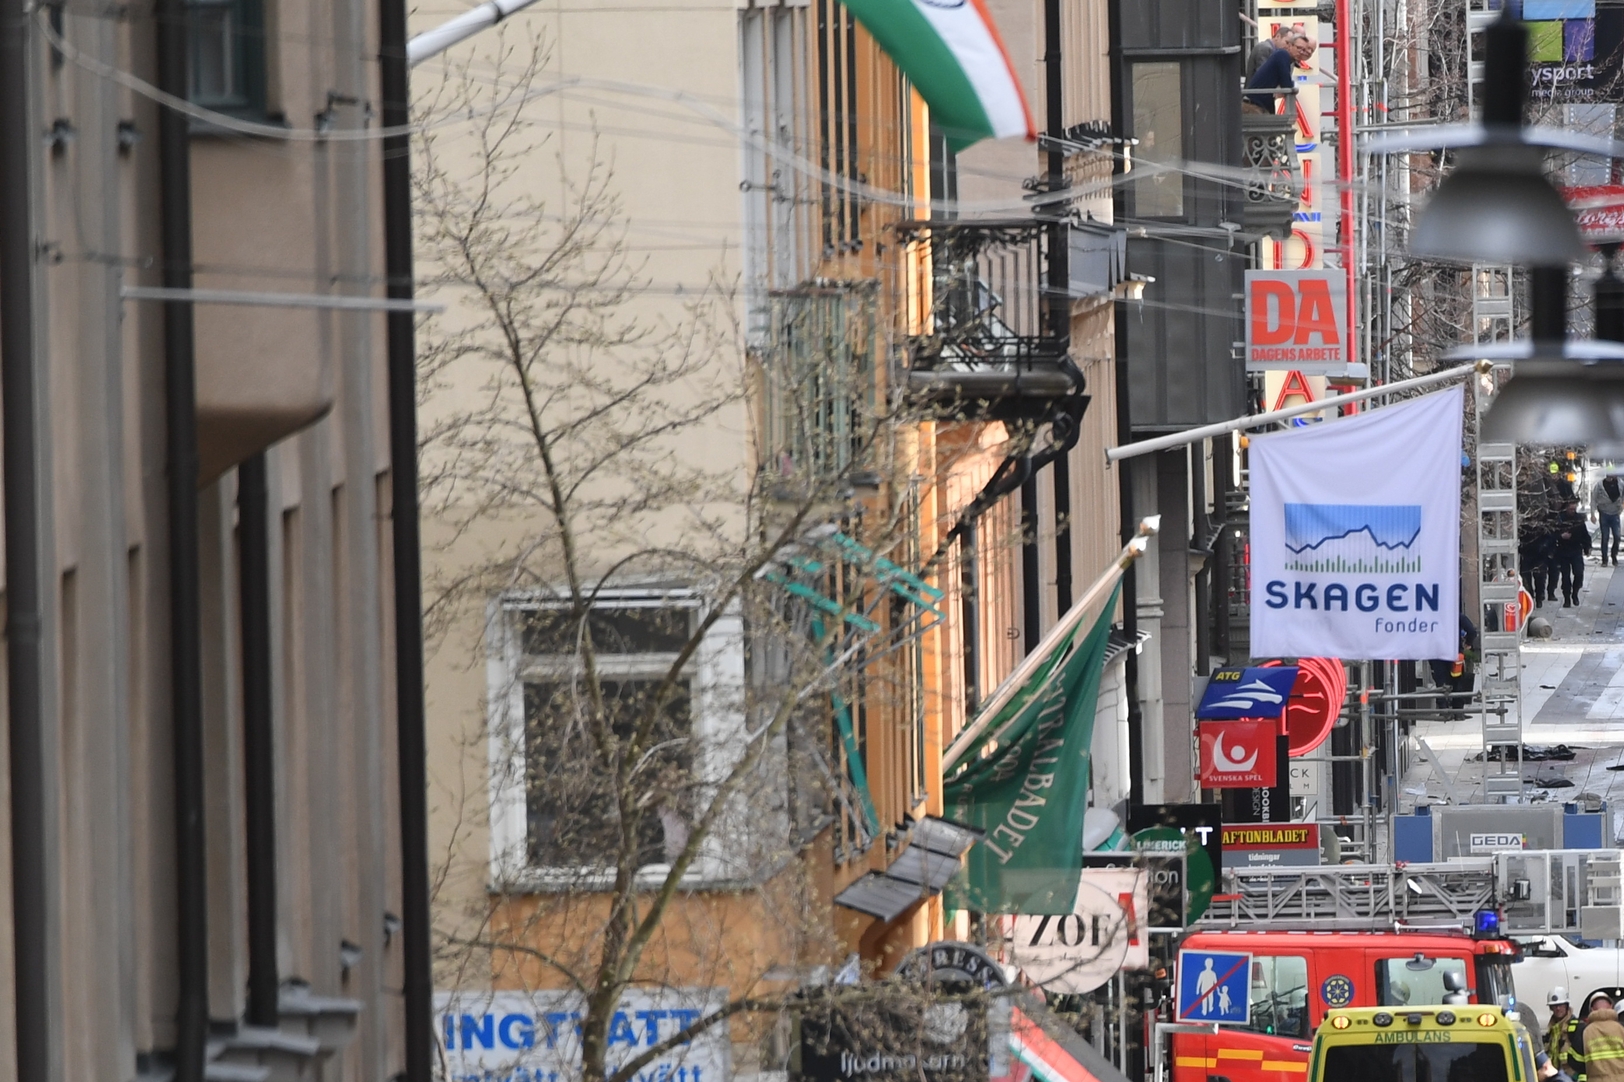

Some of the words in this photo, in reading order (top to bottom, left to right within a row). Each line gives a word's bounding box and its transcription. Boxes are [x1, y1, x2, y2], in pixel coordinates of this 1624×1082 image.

[1250, 279, 1340, 346] DA
[1252, 348, 1297, 361] DAGENS
[1298, 347, 1341, 361] ARBETE
[1265, 580, 1439, 612] SKAGEN
[1375, 618, 1439, 633] fonder
[1215, 671, 1241, 681] ATG
[1244, 774, 1263, 782] SPEL
[1222, 829, 1308, 845] AFTONBLADET
[1472, 836, 1521, 846] GEDA
[1248, 852, 1281, 863] tidningar
[1375, 1031, 1452, 1044] AMBULANS
